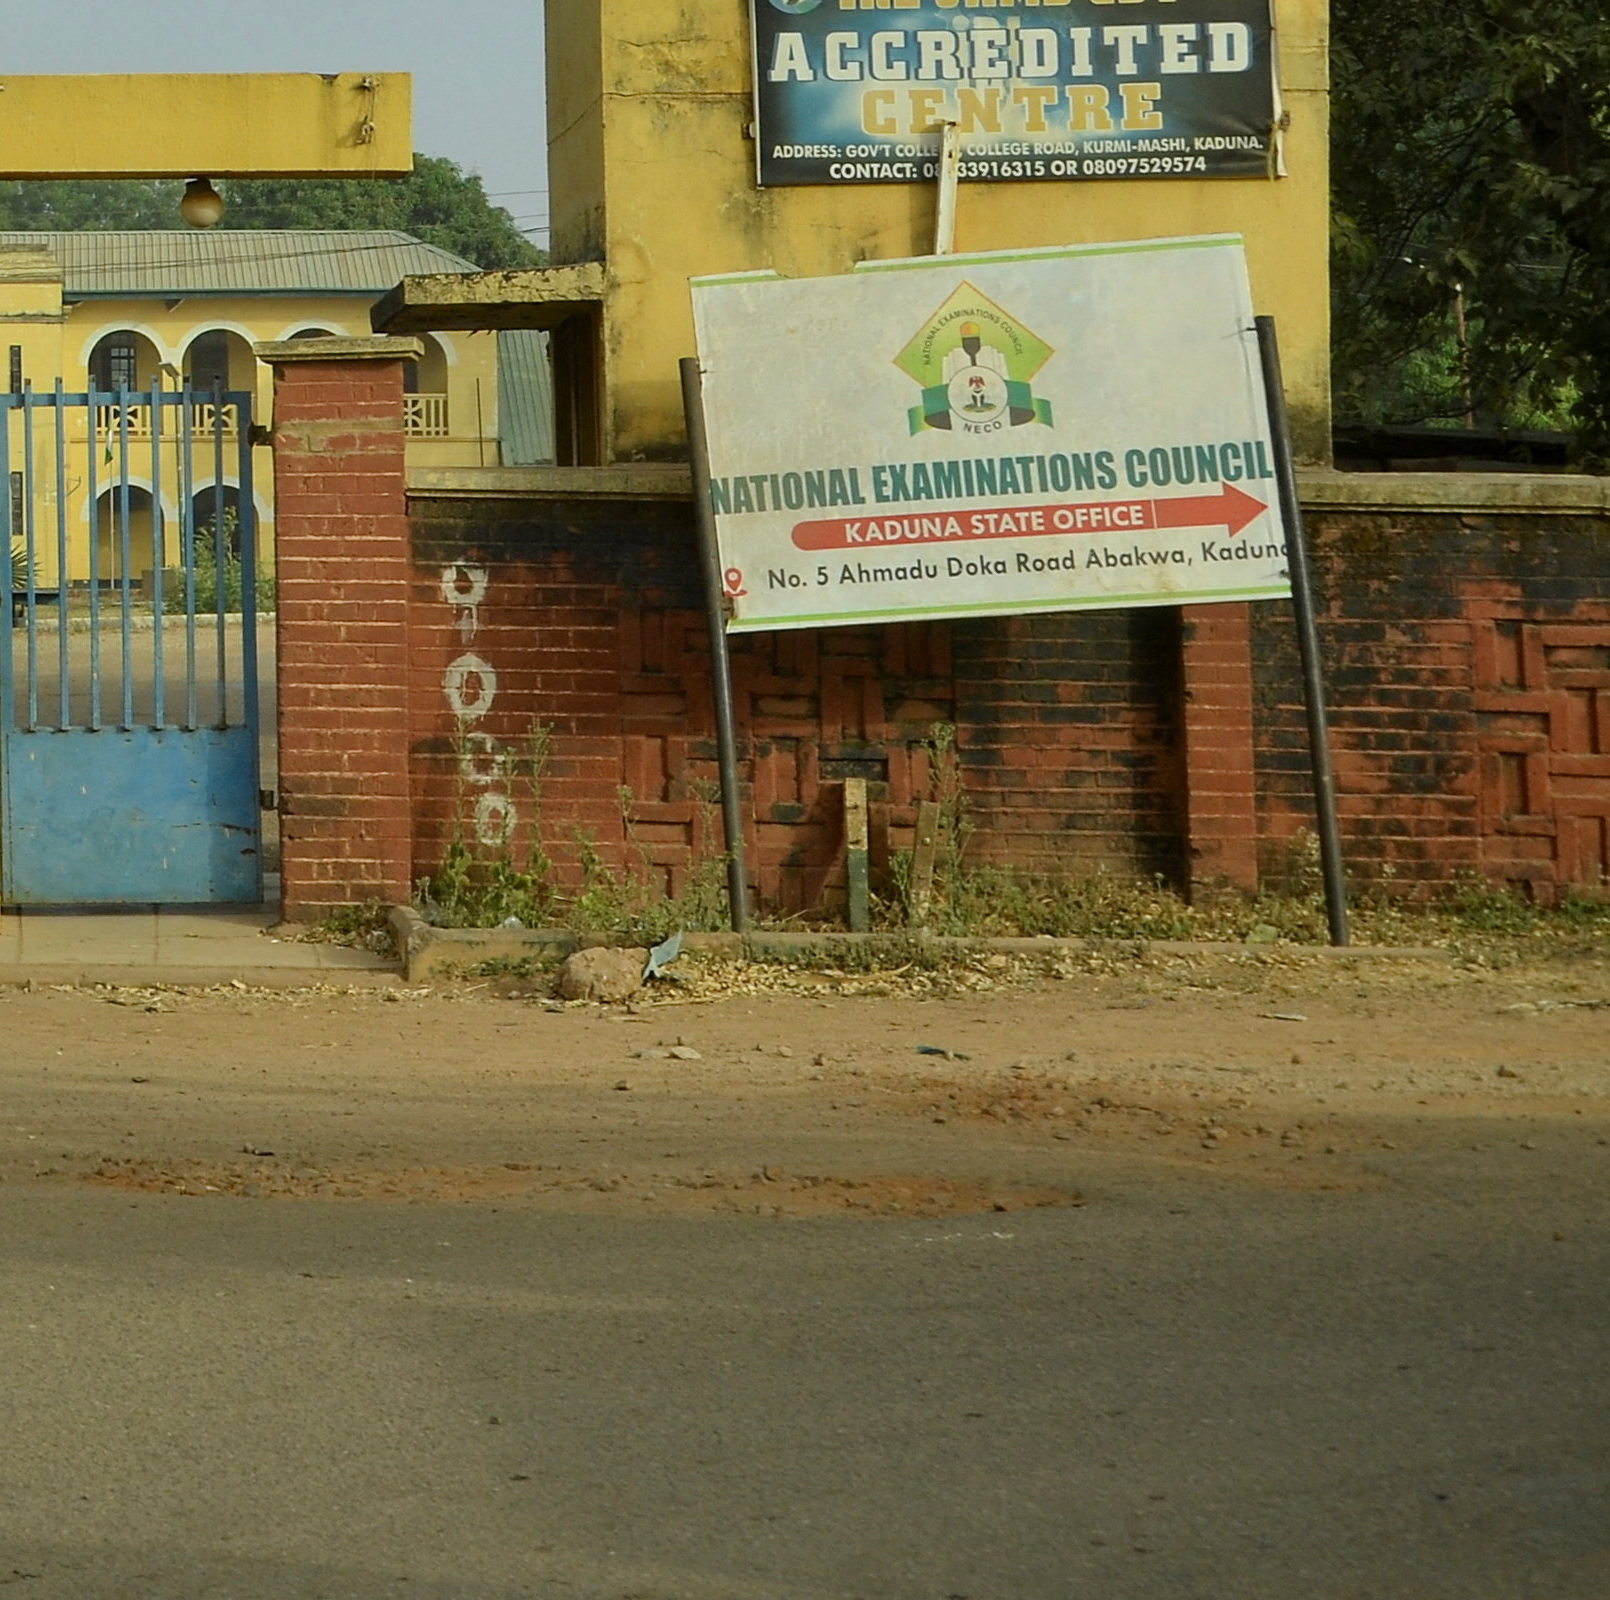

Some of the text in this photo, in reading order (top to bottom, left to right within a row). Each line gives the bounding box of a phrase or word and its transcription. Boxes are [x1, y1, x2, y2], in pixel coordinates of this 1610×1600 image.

[769, 20, 1253, 82] ACCREDITED
[860, 81, 1164, 136] CENTRE
[772, 143, 842, 160] ADDRESS:
[844, 142, 892, 159] GOV'T
[966, 141, 1031, 157] COLLEGE
[1033, 140, 1079, 157] ROAD,
[1083, 136, 1191, 154] KURMI-MASHI,
[1193, 135, 1264, 151] KADUNA.
[829, 161, 918, 180] CONTACT:
[1050, 158, 1078, 176] OR
[1082, 155, 1207, 175] 08097529574
[922, 308, 1024, 366] NATIONAL EXAMINATIONS COUNCIL
[962, 420, 1003, 435] NECO
[710, 440, 1274, 516] NATIONAL EXAMINATIONS COUNCIL
[844, 504, 1145, 544] KADUNA STATE OFFICE
[767, 568, 808, 590] No.
[816, 566, 829, 586] 5
[839, 558, 938, 585] Ahmadu
[947, 554, 1008, 578] Doka
[1015, 549, 1076, 573] Road
[1085, 545, 1193, 569] Abakwa,
